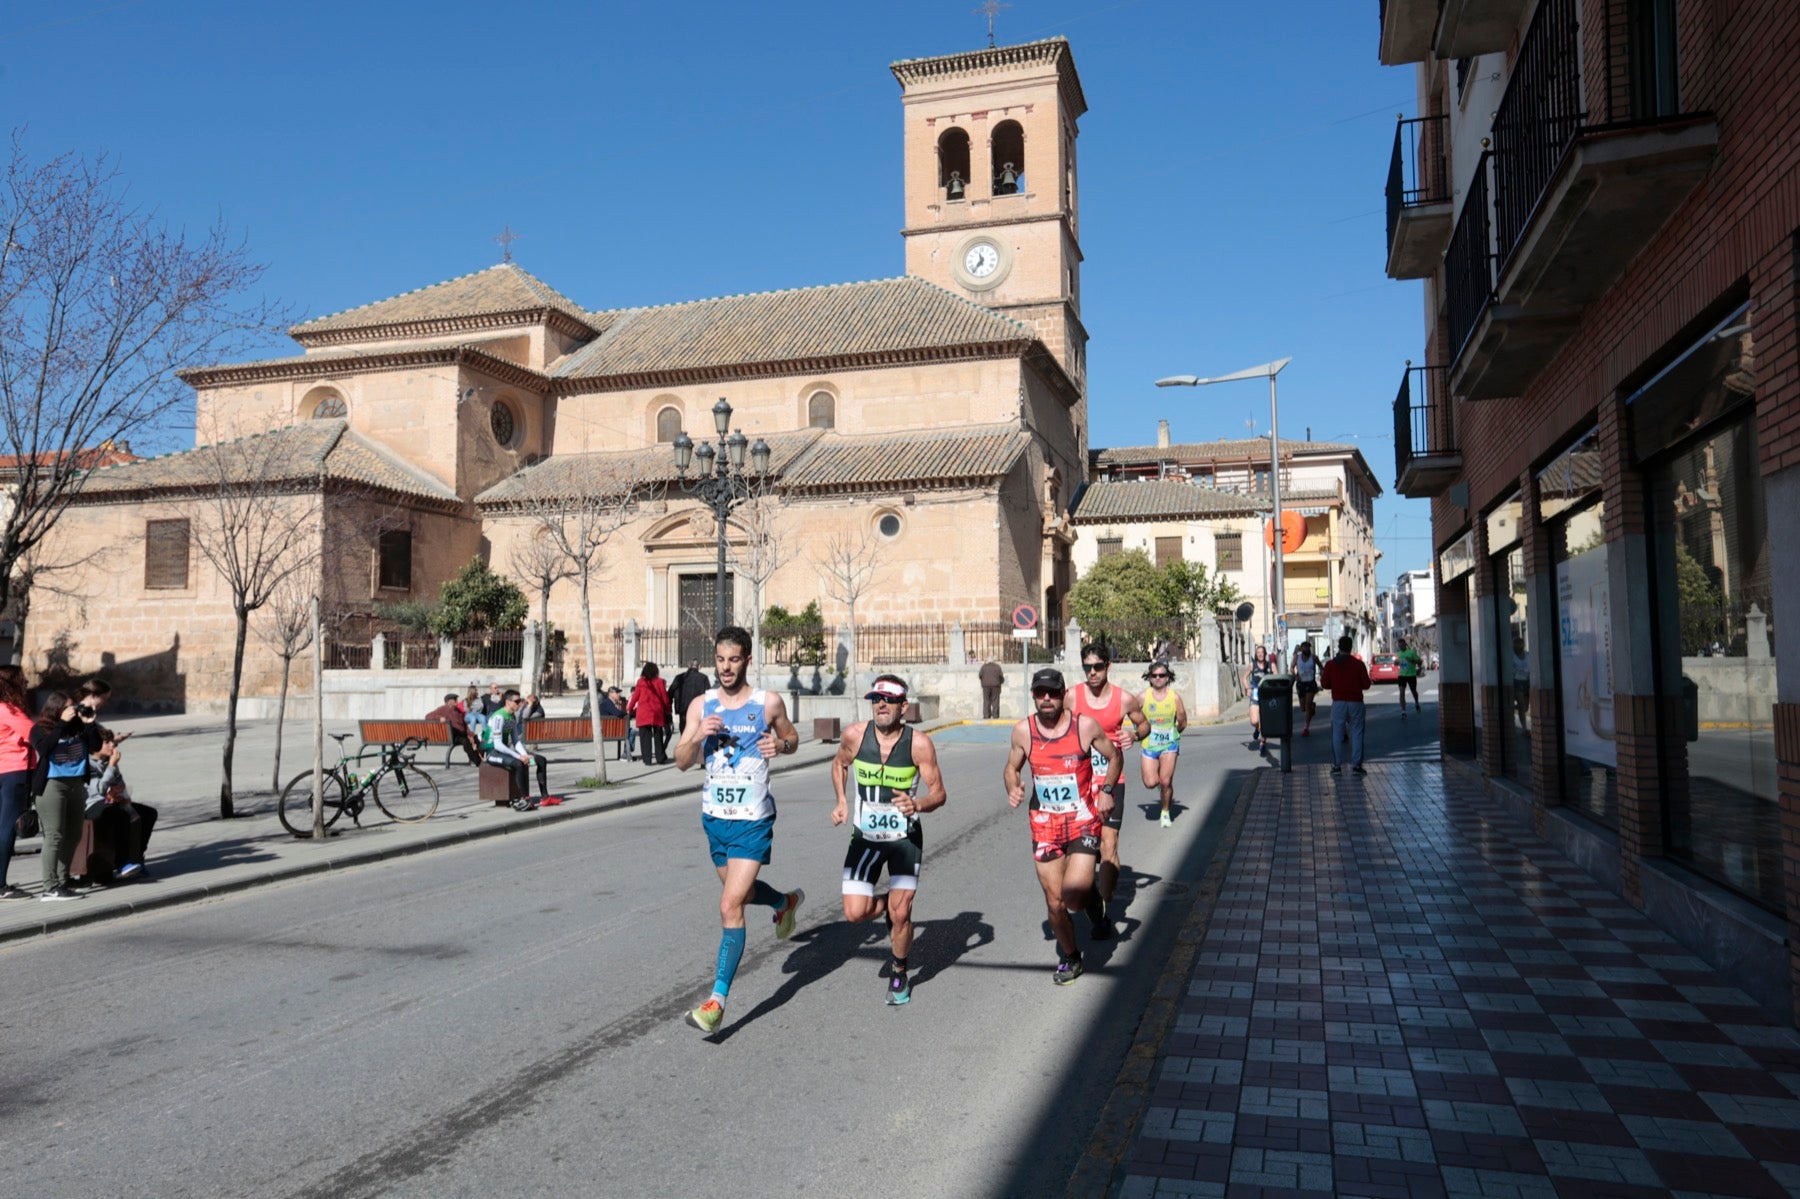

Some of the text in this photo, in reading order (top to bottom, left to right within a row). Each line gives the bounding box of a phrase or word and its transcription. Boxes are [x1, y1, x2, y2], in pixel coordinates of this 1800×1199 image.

[732, 725, 757, 734] SUMA
[1153, 733, 1170, 741] 794
[716, 787, 747, 804] 557
[1042, 786, 1072, 802] 412
[868, 814, 900, 830] 346
